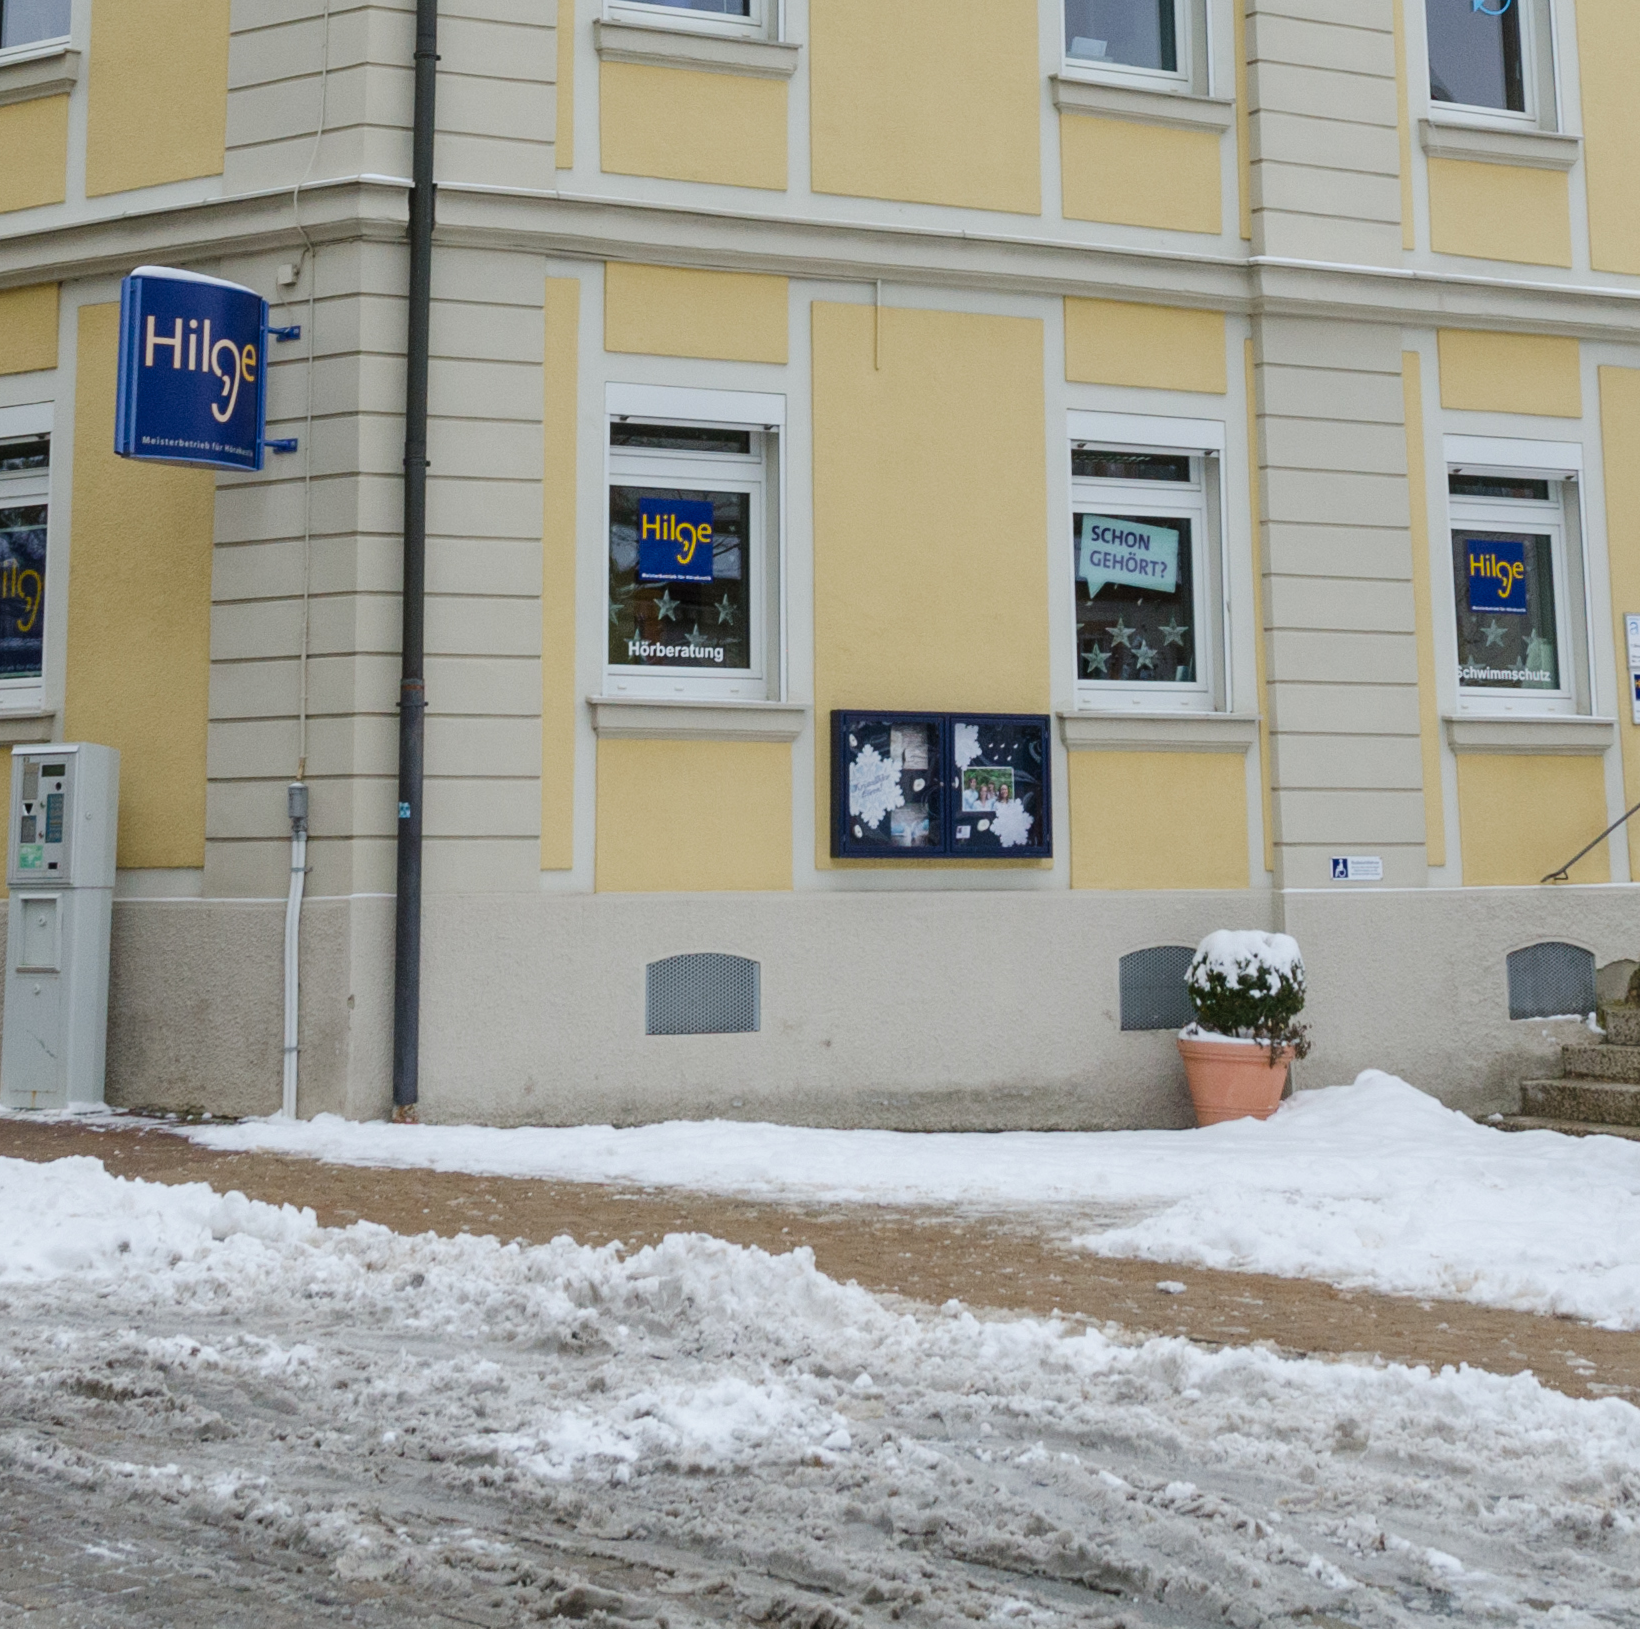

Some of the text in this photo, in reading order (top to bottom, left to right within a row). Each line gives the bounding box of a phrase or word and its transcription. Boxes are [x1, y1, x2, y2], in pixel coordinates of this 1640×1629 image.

[145, 315, 256, 422] Hilge
[142, 436, 210, 450] Meisterbetrieb
[212, 441, 223, 451] für
[642, 514, 711, 564] Hilge
[1091, 525, 1151, 551] SCHON
[1089, 551, 1168, 578] GEHÖRT?
[1470, 554, 1524, 598] Hilge
[628, 643, 724, 661] Hörberatung
[1458, 667, 1551, 682] Schwimmschutz
